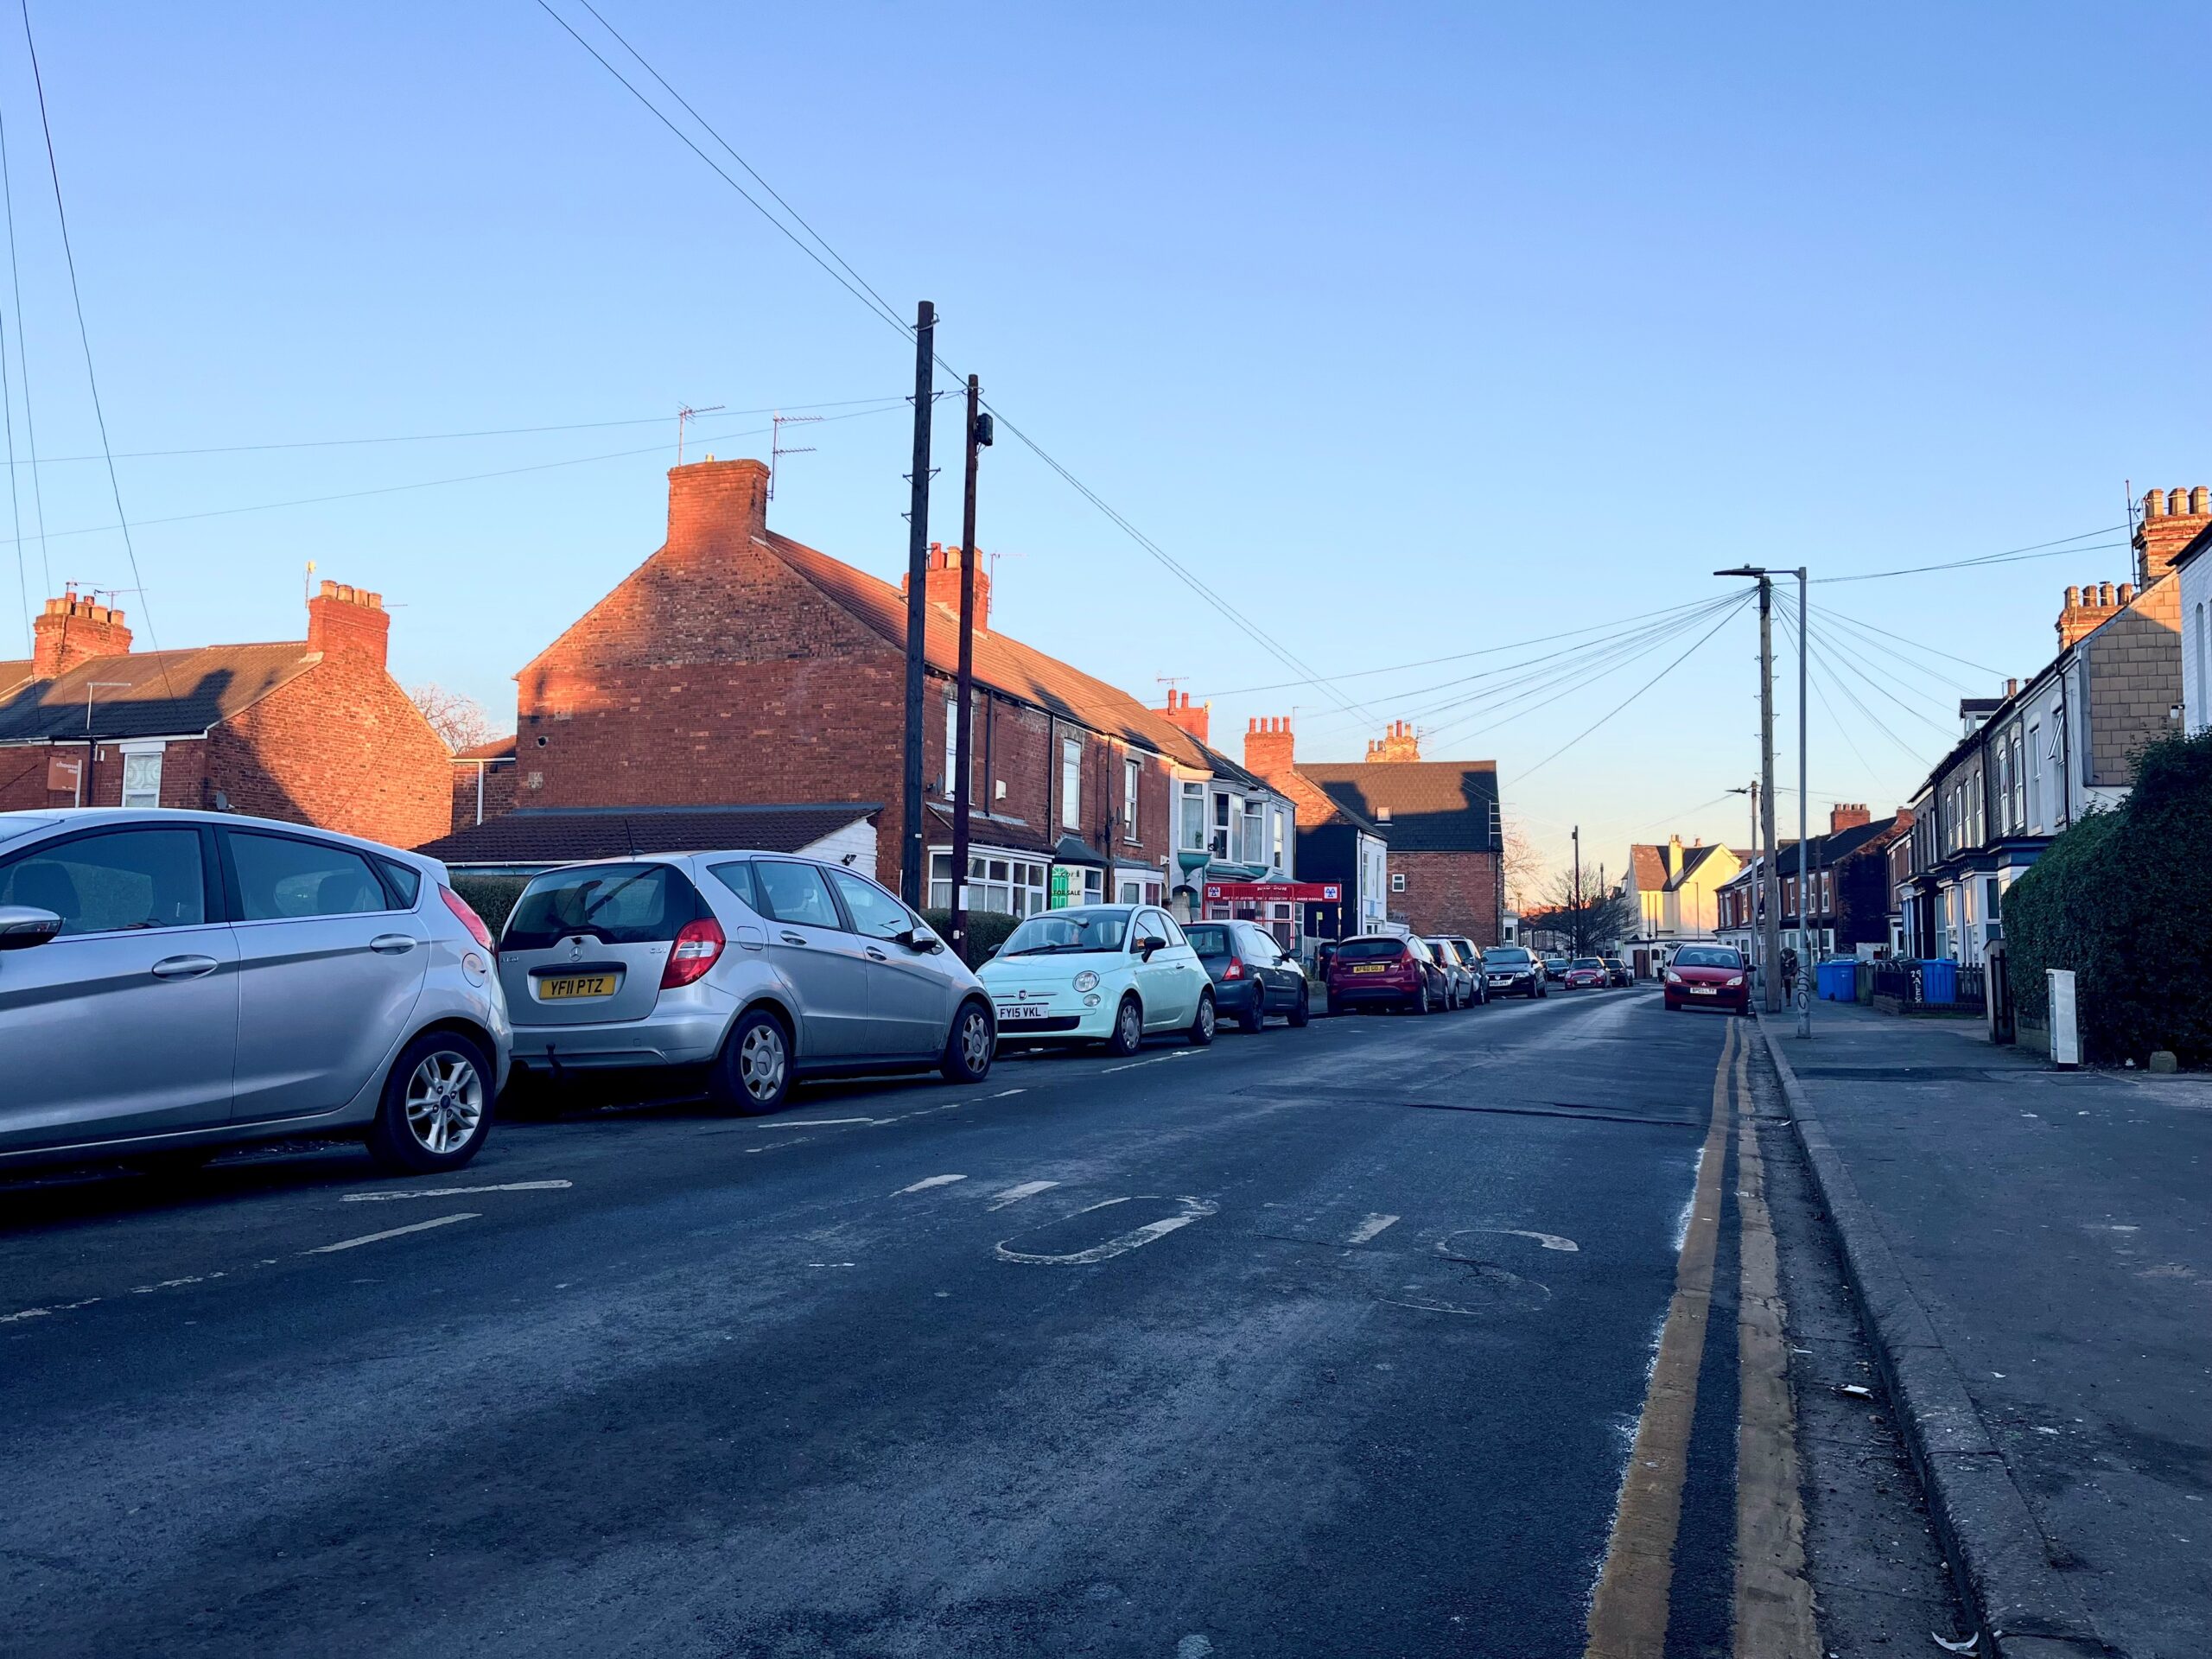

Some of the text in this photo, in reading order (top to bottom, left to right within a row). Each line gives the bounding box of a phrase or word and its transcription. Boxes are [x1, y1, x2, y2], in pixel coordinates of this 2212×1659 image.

[551, 978, 604, 995] YF11 PTZ
[1000, 1007, 1041, 1018] FY15 VKL
